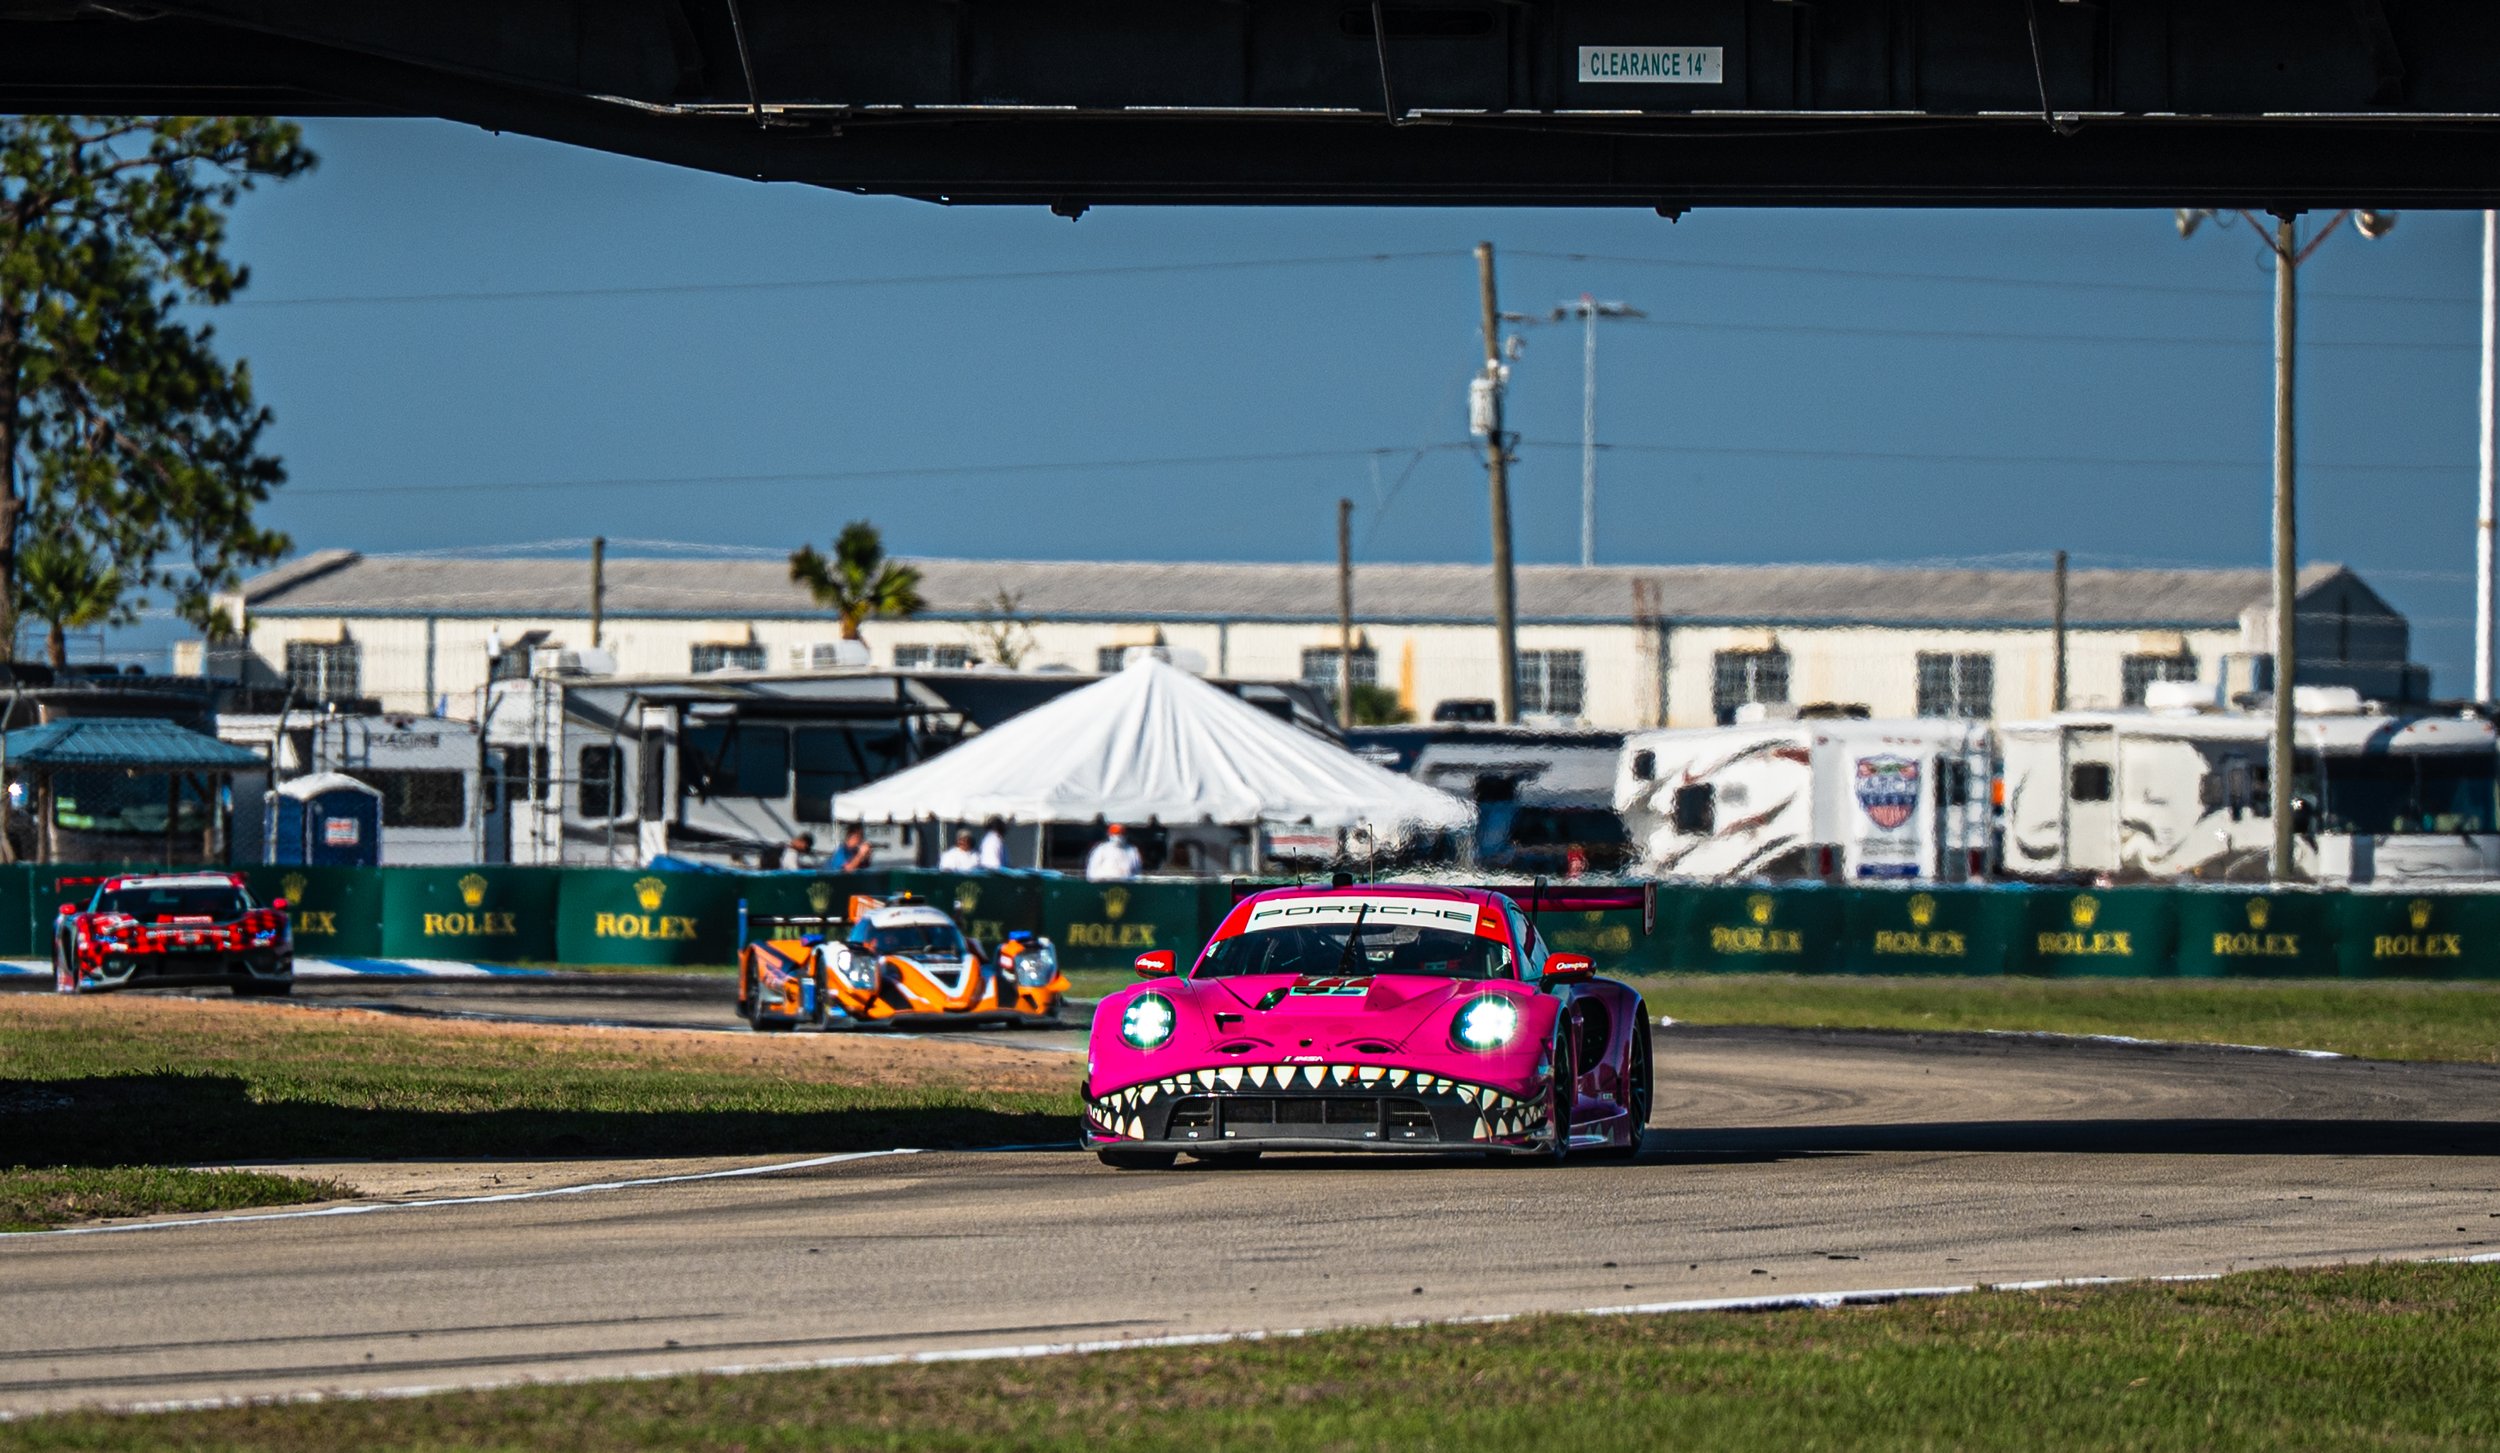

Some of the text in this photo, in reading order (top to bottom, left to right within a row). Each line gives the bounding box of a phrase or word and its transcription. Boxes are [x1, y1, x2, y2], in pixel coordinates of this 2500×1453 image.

[1590, 52, 1706, 76] CLEARANCE 14'
[423, 912, 517, 936] ROLEX
[595, 912, 697, 938] ROLEX
[1254, 905, 1473, 923] PORSCHE
[1067, 923, 1155, 947] ROLEX
[2037, 932, 2132, 955] ROLEX
[2213, 933, 2299, 955] ROLEX
[2373, 934, 2461, 956] ROLEX
